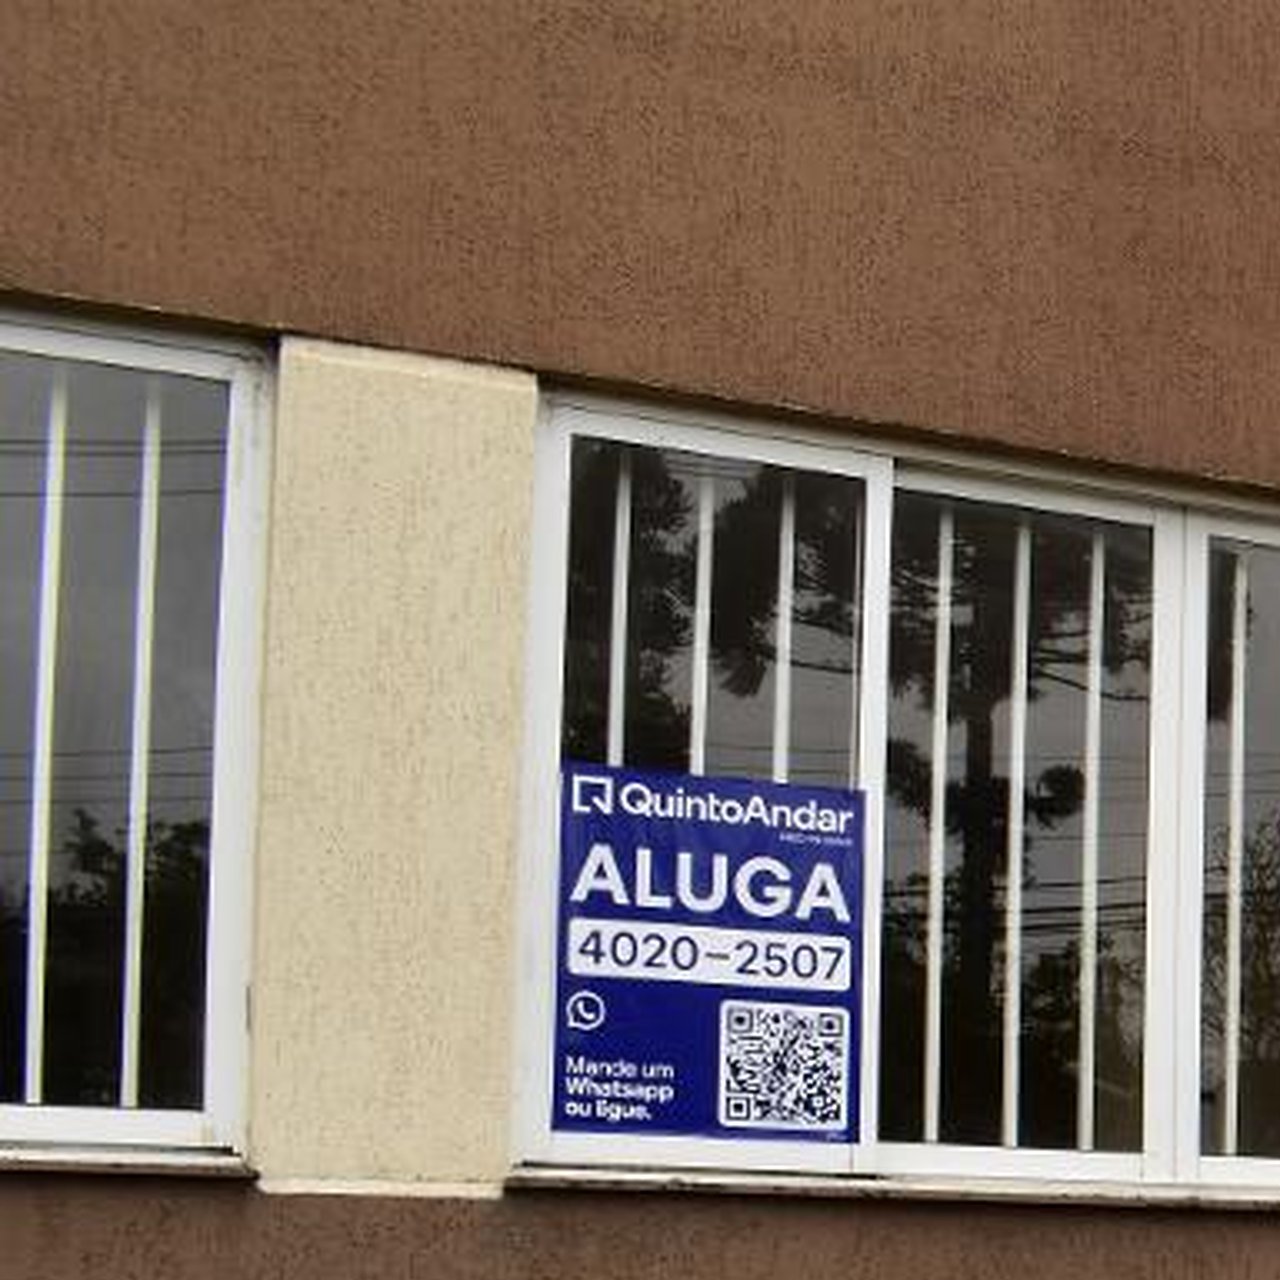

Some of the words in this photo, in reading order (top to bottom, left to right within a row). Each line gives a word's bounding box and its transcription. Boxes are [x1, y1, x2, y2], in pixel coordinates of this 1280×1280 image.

[620, 782, 854, 834] QuintoAndar
[569, 843, 851, 923] ALUGA
[577, 929, 845, 981] 4020-2507
[565, 1055, 638, 1078] Mande
[642, 1063, 675, 1079] um
[565, 1102, 593, 1117] ou
